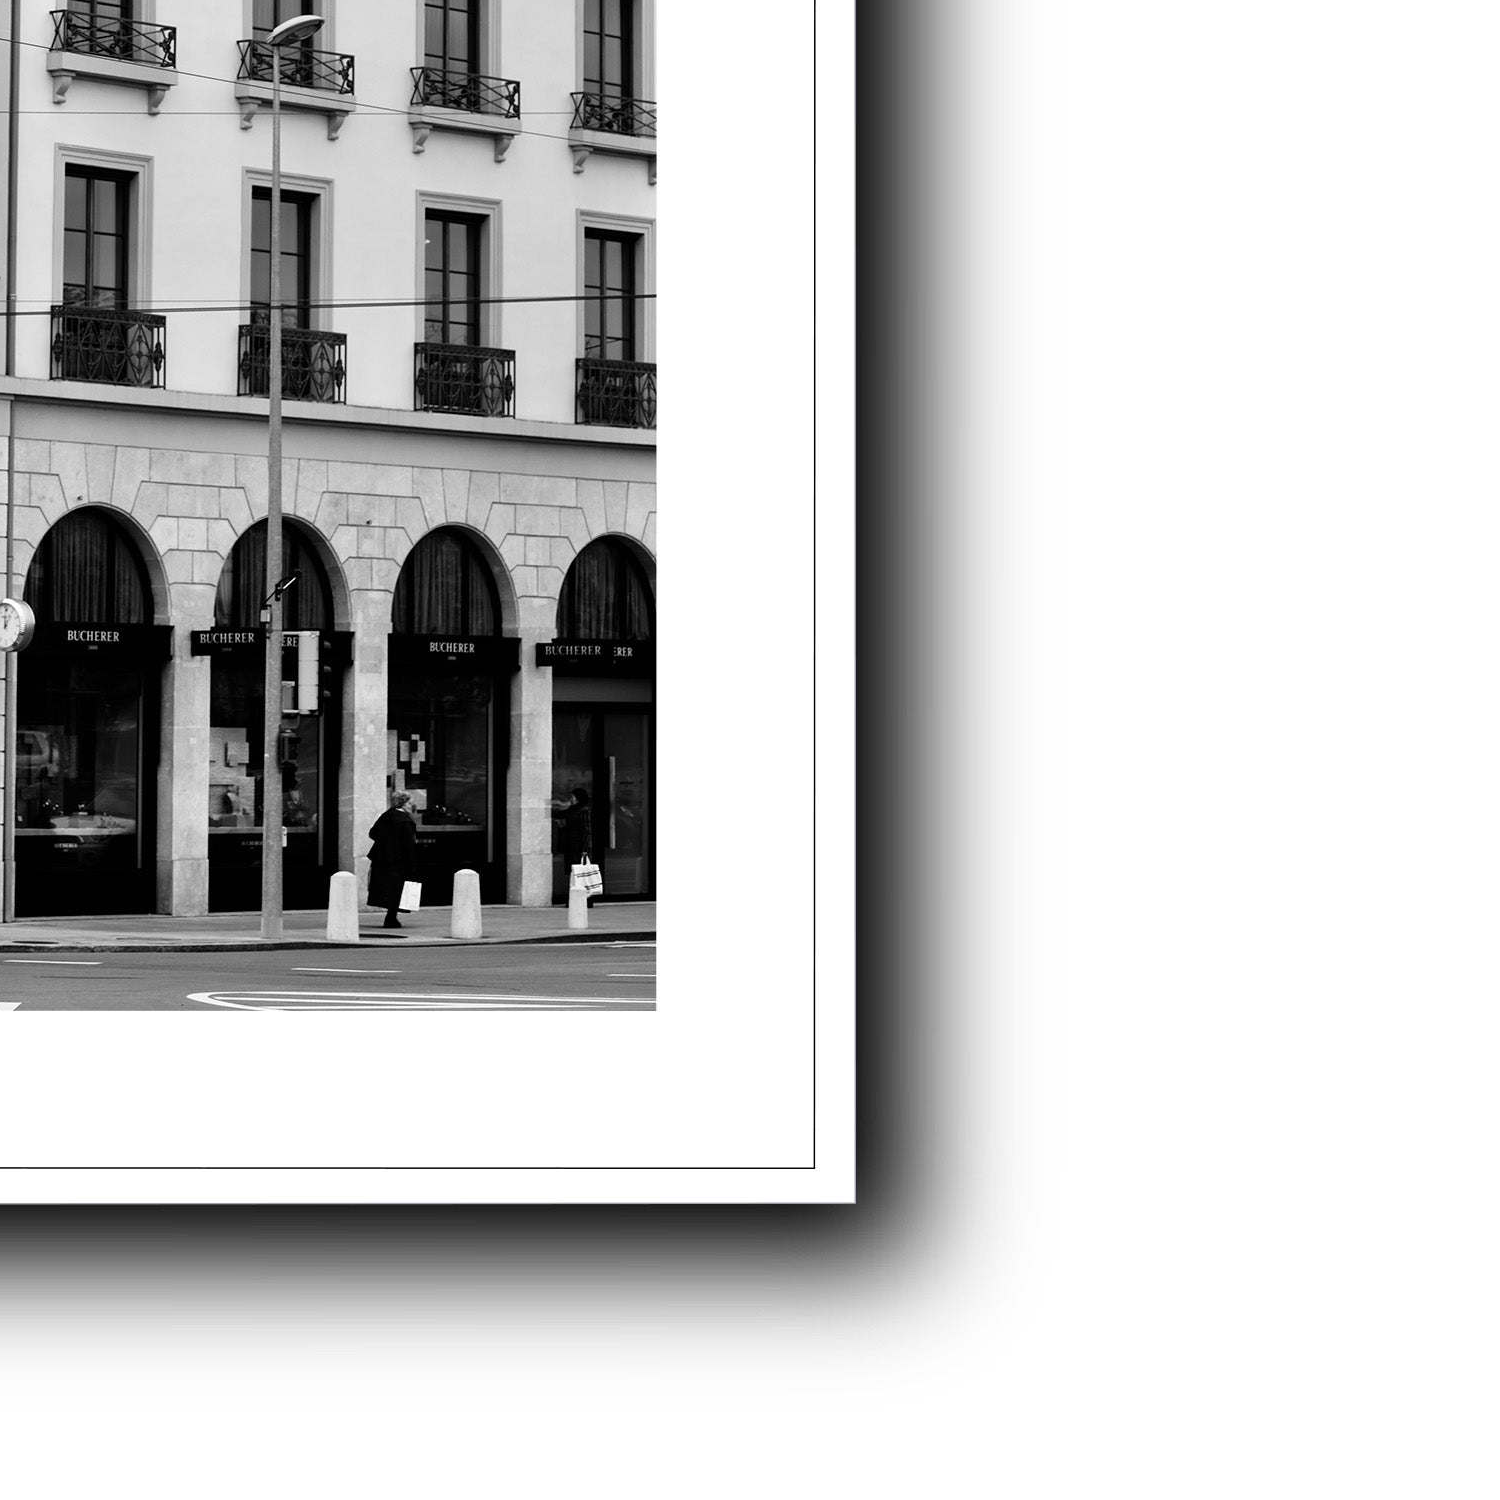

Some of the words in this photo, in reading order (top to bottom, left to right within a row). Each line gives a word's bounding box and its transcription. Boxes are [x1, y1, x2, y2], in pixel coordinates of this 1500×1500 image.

[67, 629, 120, 642] BUCHERER
[200, 632, 255, 644] BUCHERER
[429, 641, 475, 653] BUCHERER
[545, 645, 601, 656] BUCHERER
